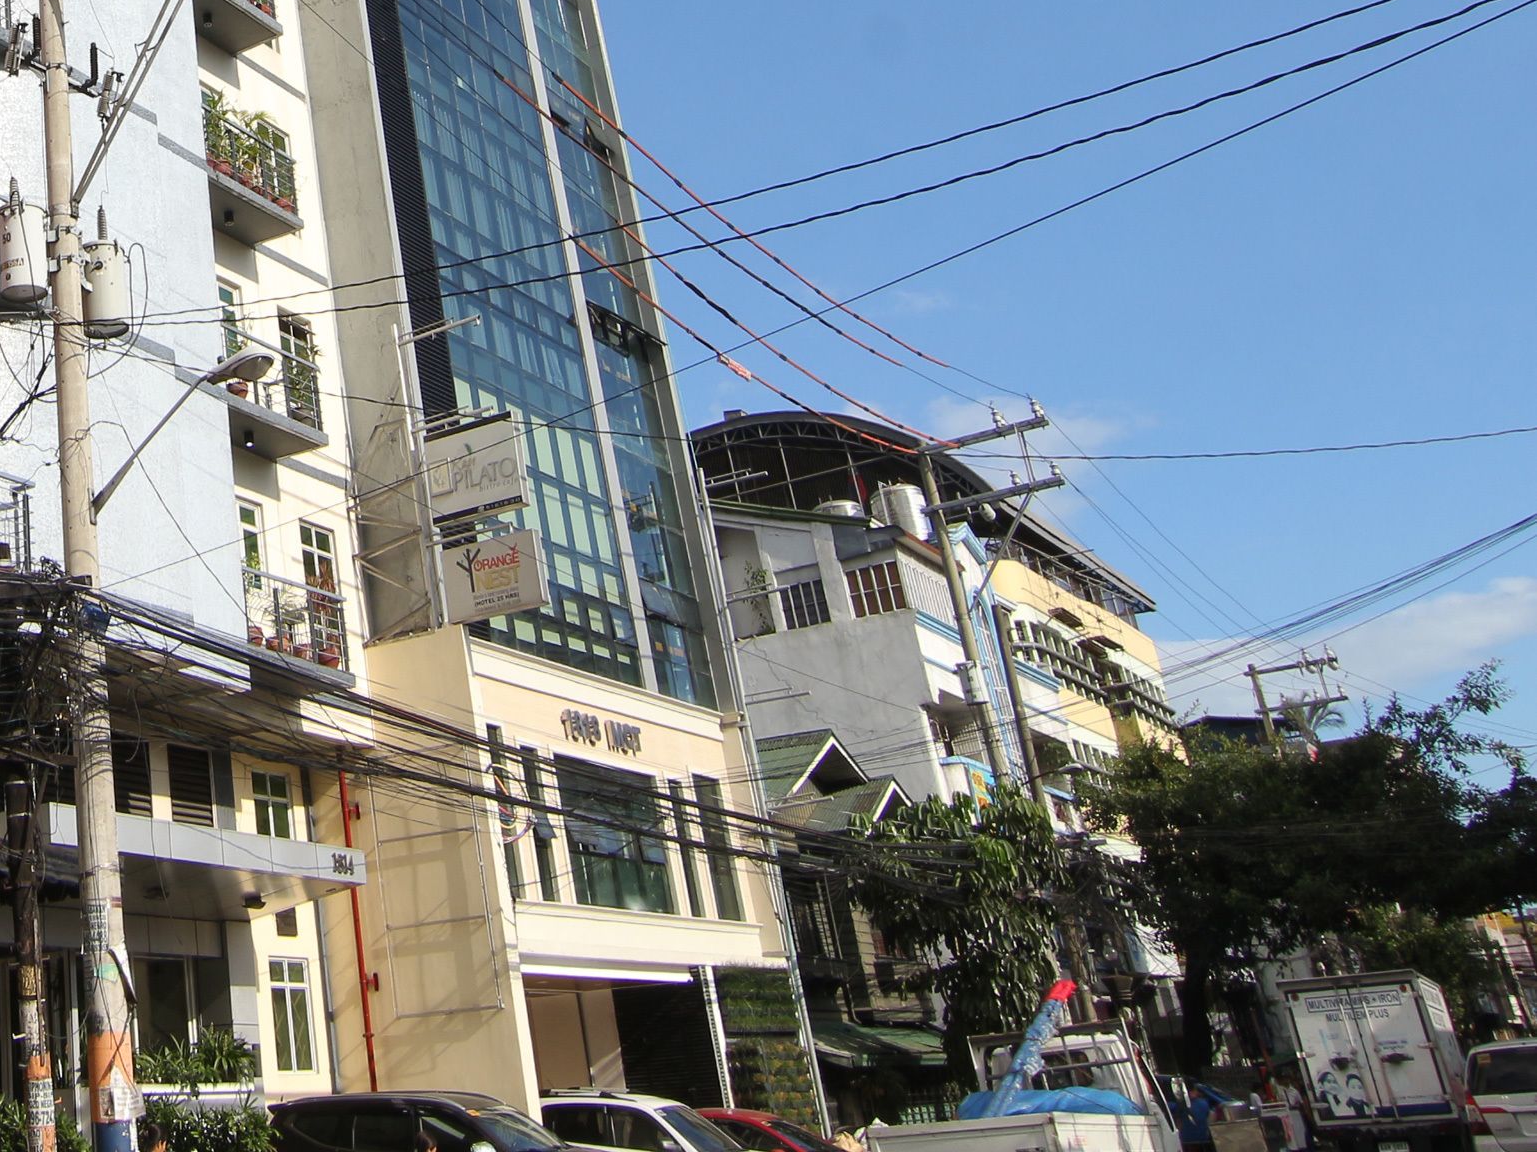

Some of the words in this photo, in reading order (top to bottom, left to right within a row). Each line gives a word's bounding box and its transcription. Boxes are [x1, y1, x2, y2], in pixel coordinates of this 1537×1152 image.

[452, 457, 516, 492] PILATO
[474, 550, 520, 572] ORANGE
[474, 565, 520, 594] NEST
[1378, 993, 1400, 1004] IRON
[1369, 1008, 1389, 1020] PLUS
